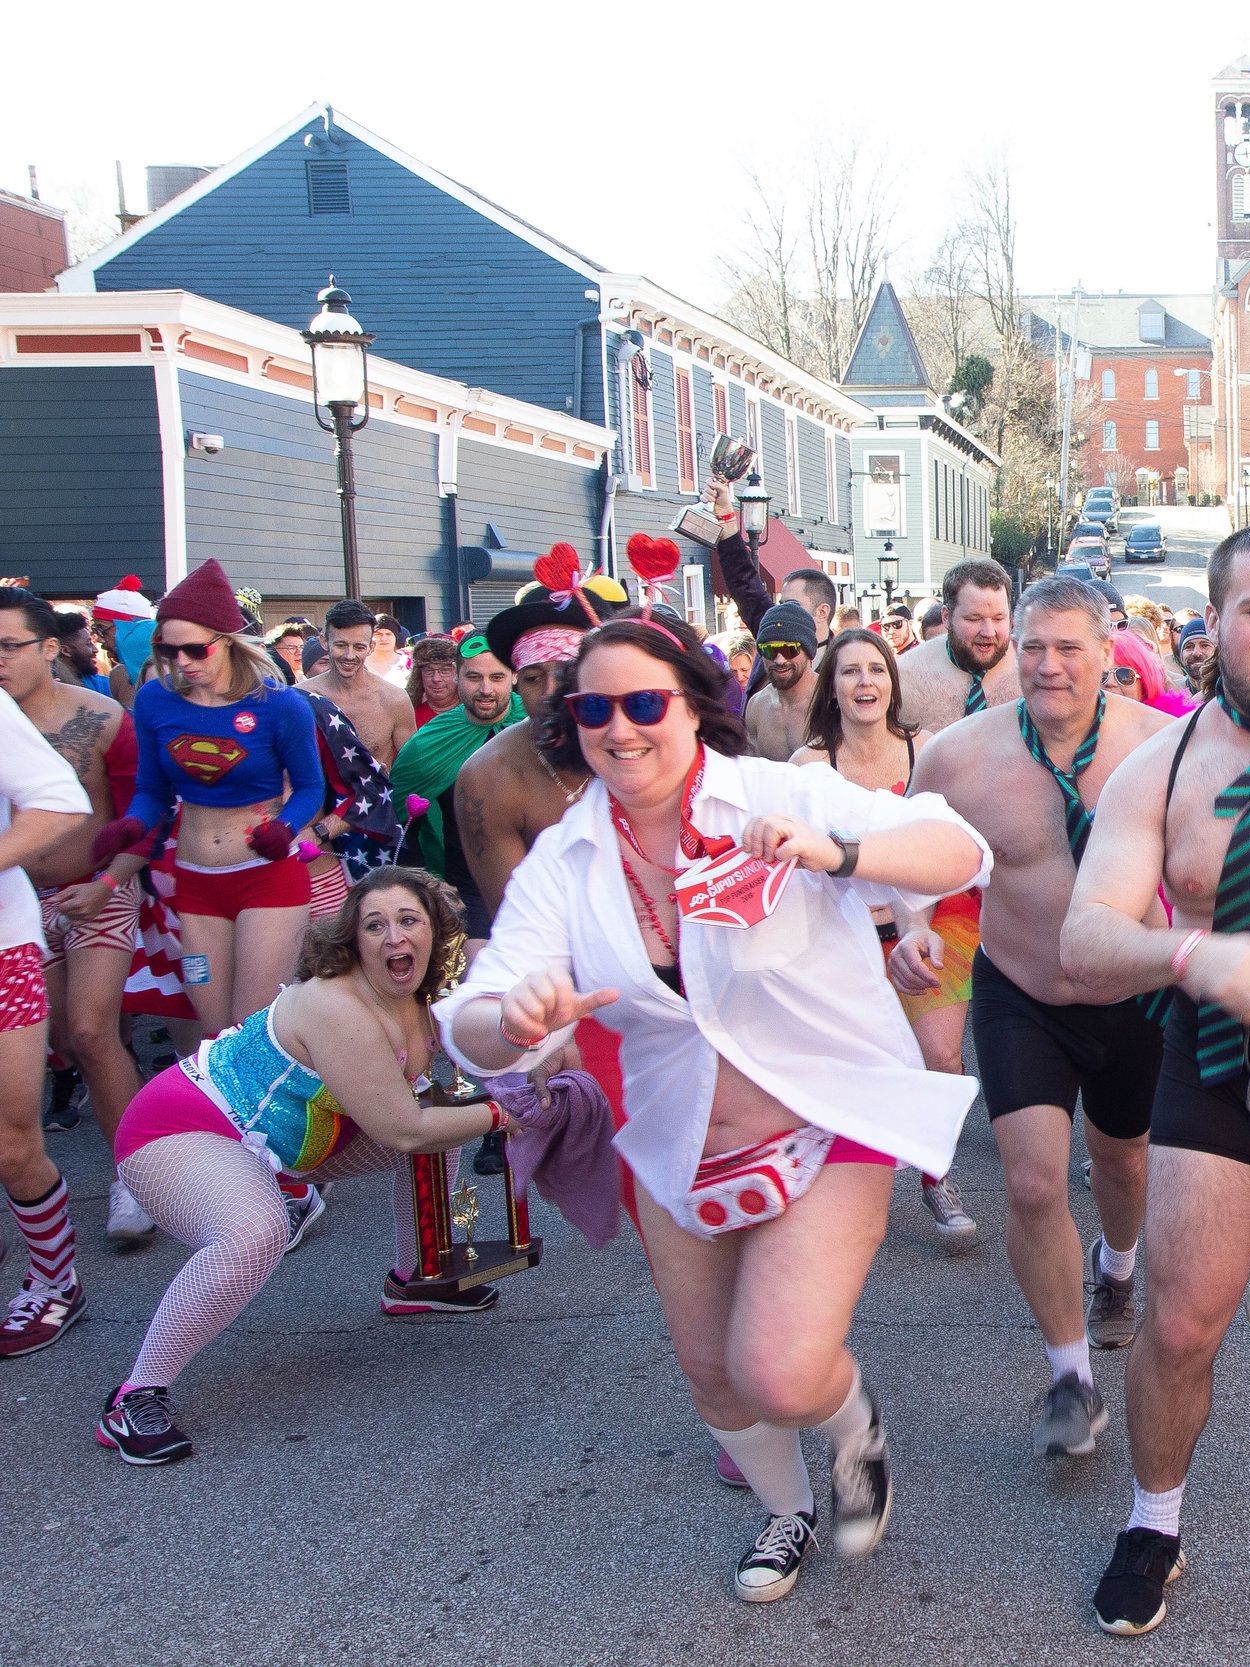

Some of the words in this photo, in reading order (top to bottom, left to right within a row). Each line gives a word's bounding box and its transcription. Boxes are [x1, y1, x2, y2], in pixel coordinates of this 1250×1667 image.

[706, 870, 744, 898] CUPID'S
[719, 896, 731, 906] TOP
[730, 875, 765, 900] FUNDRAISER
[181, 1058, 205, 1082] BOYX
